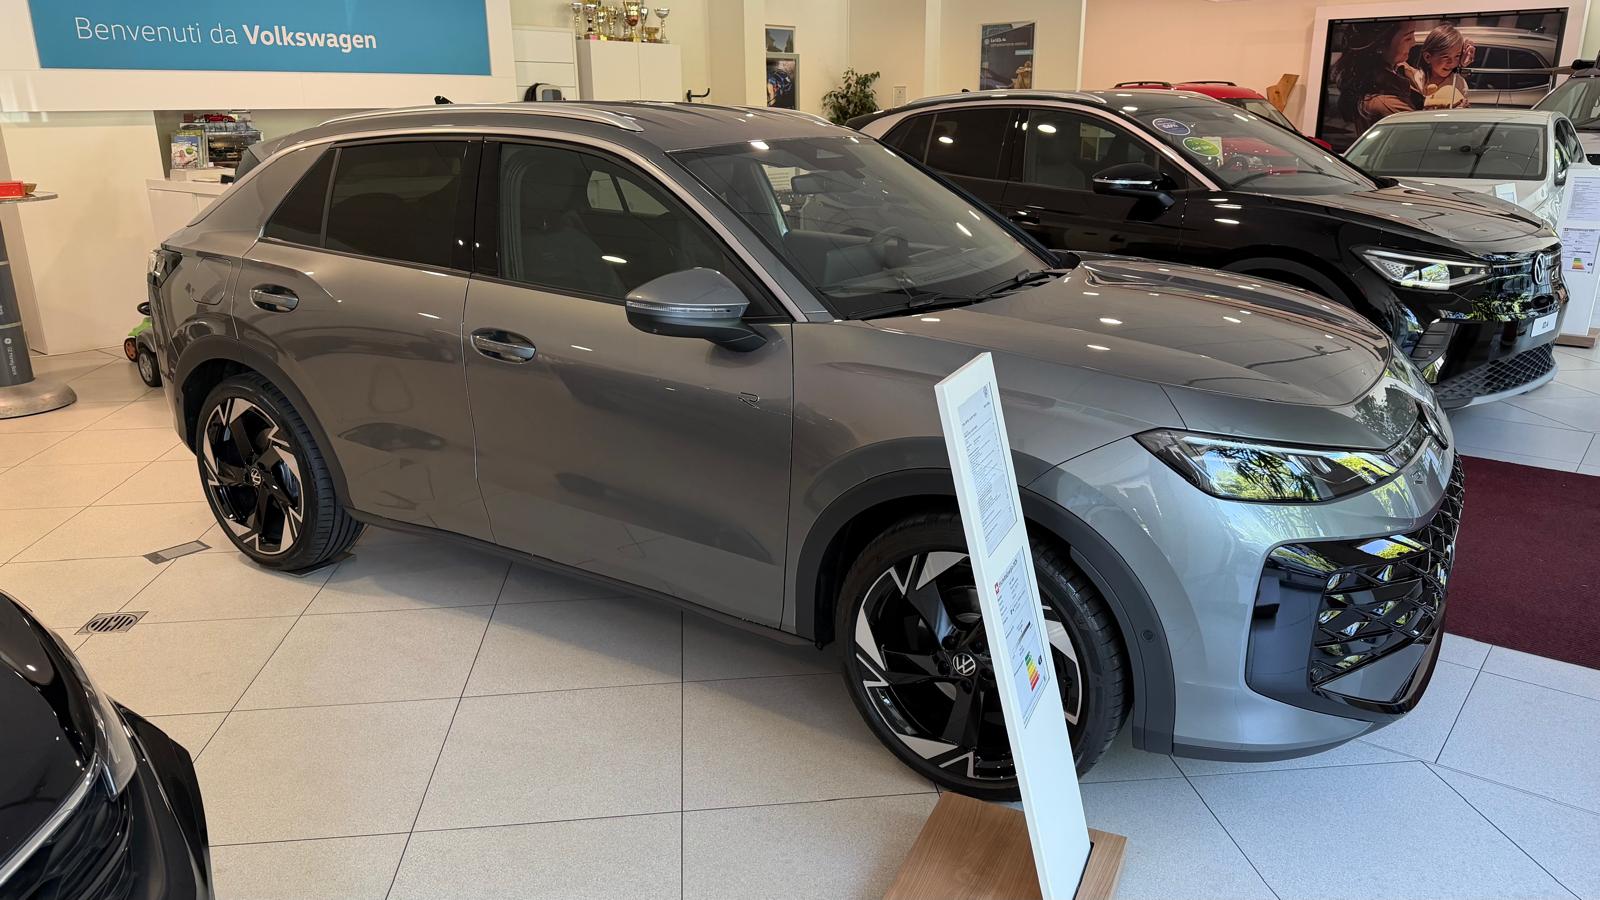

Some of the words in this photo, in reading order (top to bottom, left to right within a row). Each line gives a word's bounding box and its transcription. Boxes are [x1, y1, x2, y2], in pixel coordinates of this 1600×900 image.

[74, 16, 202, 44] Benvenuti
[210, 22, 238, 45] da
[242, 24, 377, 53] Volkswagen
